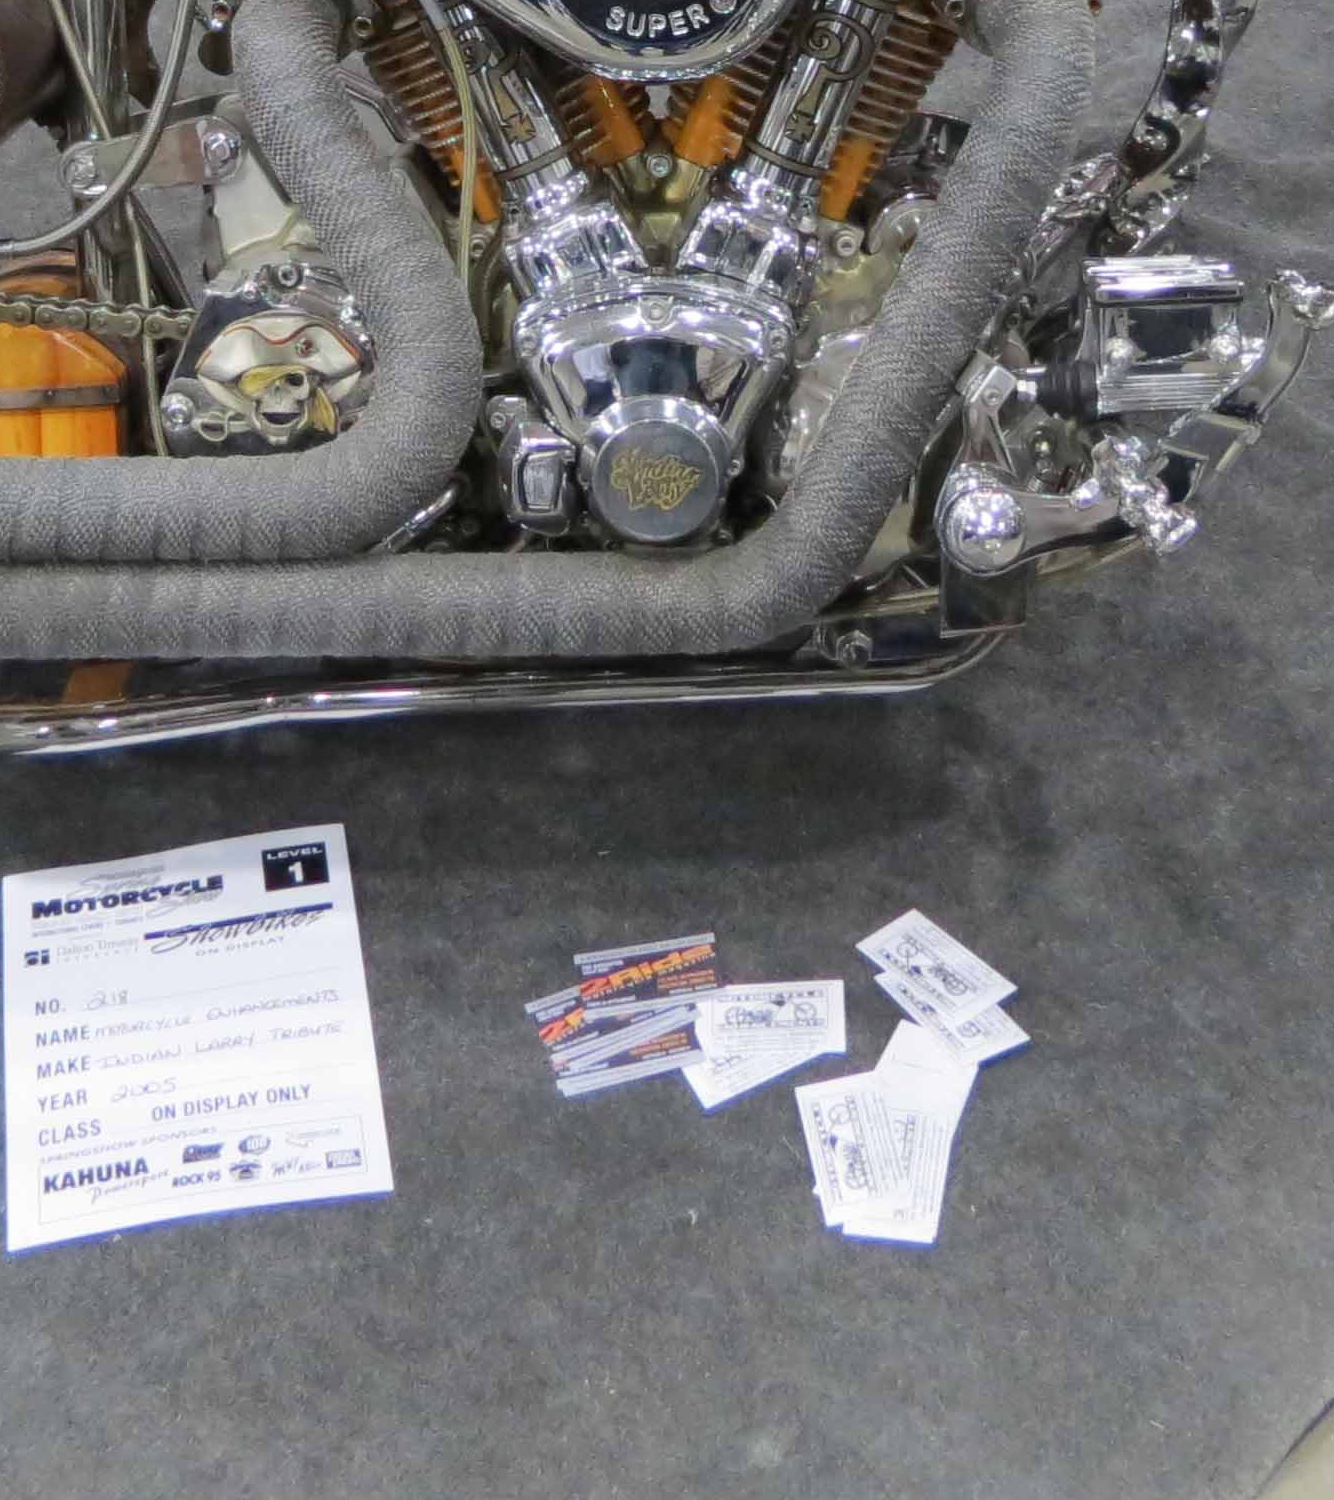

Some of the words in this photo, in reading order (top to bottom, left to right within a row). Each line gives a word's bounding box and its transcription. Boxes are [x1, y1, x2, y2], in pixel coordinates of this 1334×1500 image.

[605, 3, 710, 38] SUPER
[267, 847, 324, 861] LEVEL
[289, 861, 304, 883] 1
[35, 998, 66, 1016] NO.
[36, 1025, 92, 1049] NAME
[37, 1055, 92, 1080] MAKE
[38, 1089, 88, 1114] YEAR
[38, 1118, 102, 1147] CLASS
[151, 1105, 176, 1122] ON
[184, 1091, 259, 1117] DISPLAY
[267, 1084, 311, 1105] ONLY
[43, 1156, 149, 1194] KAHUNA
